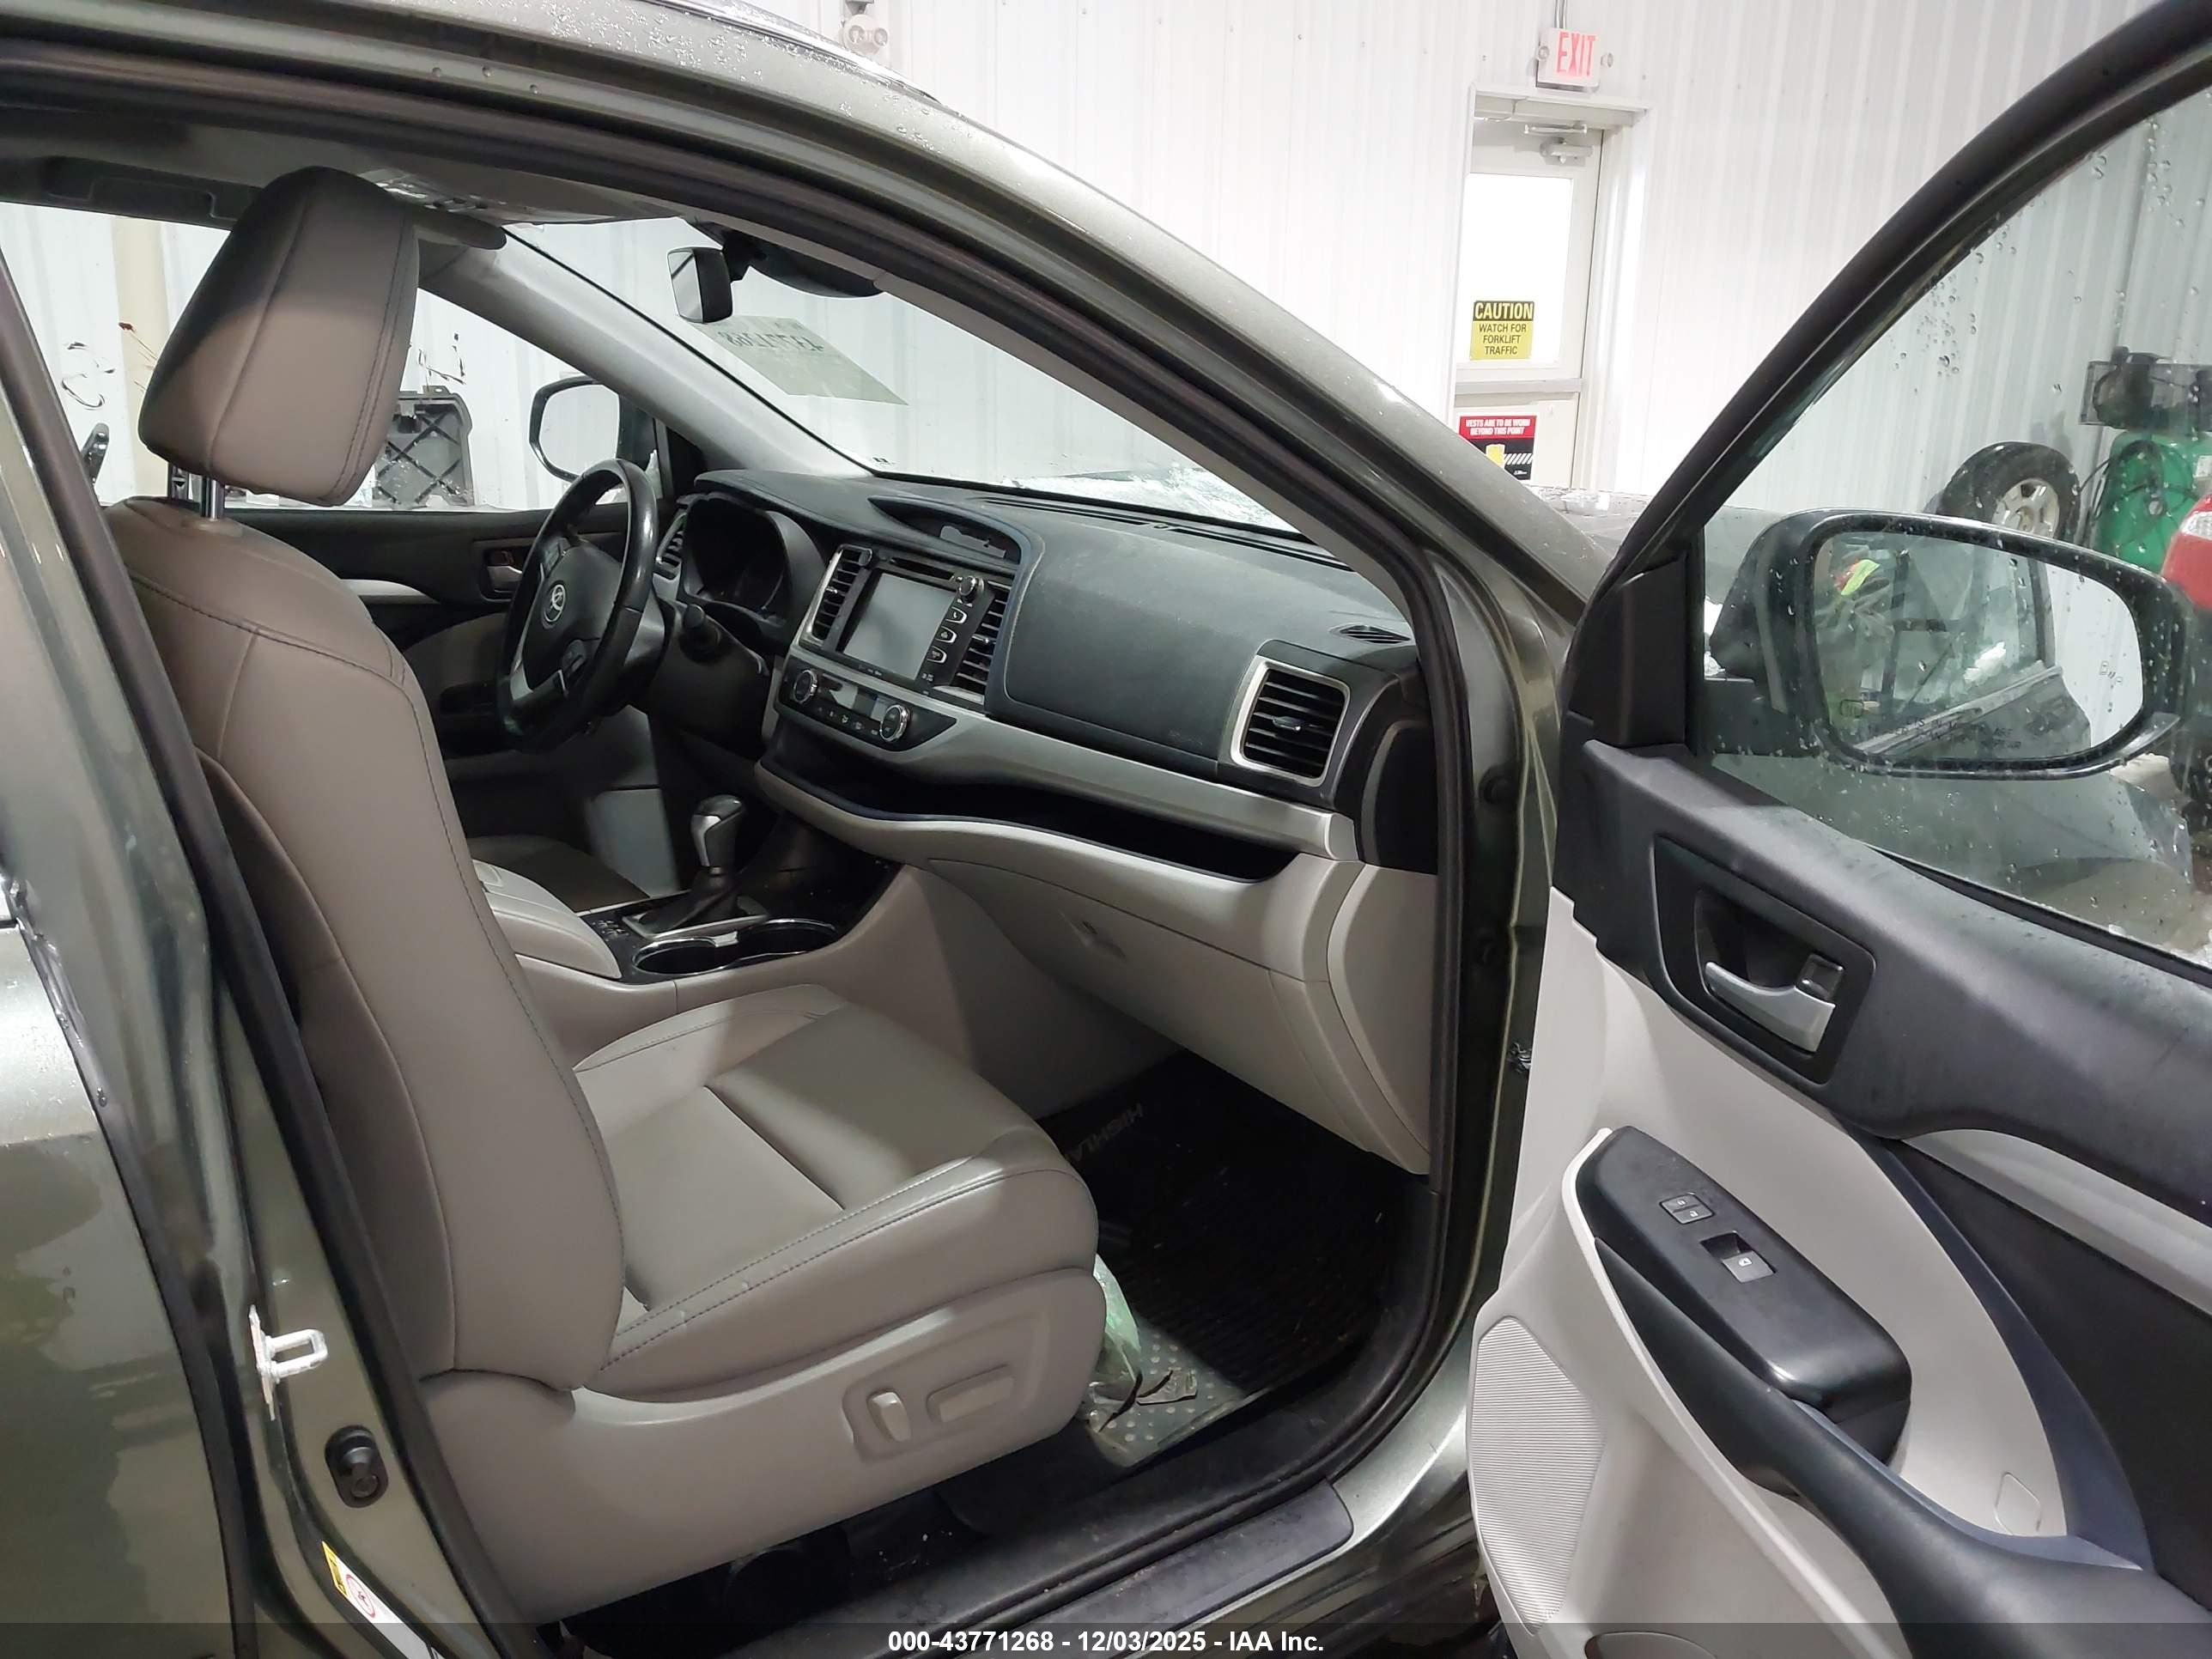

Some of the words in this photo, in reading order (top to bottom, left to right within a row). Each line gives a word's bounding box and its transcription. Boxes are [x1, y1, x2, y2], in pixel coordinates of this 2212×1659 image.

[1557, 32, 1596, 76] EXIT
[1474, 301, 1534, 319] CAUTION
[1479, 324, 1509, 332] WATCH
[1510, 324, 1527, 332] FOR
[1483, 335, 1522, 343] FORKLIFT
[1485, 346, 1518, 355] TRAFFIC
